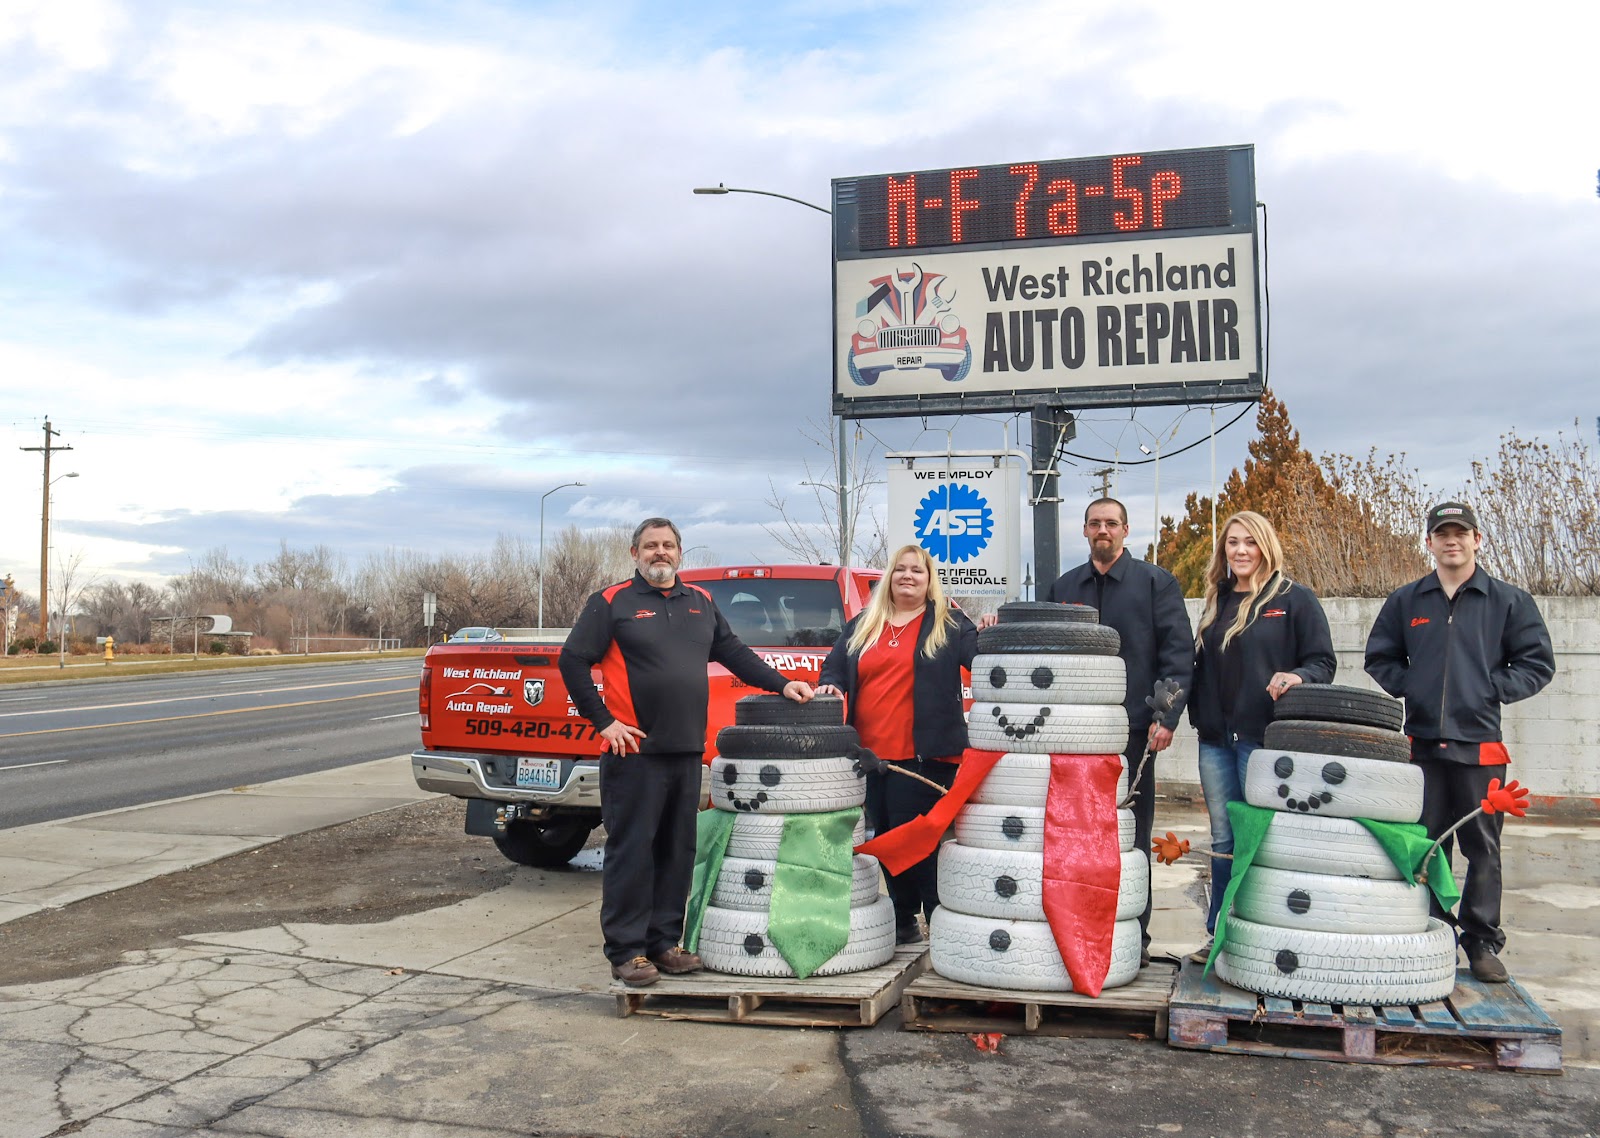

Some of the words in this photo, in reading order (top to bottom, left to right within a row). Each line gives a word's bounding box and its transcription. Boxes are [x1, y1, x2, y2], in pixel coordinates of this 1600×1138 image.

[888, 169, 980, 247] M-F
[1009, 156, 1182, 238] 7a-5p
[981, 265, 1069, 302] West
[1082, 247, 1236, 297] Richland
[982, 306, 1086, 373] AUTO
[1098, 298, 1240, 367] REPAIR
[896, 355, 923, 366] REPAIR
[914, 471, 936, 480] WE
[938, 470, 994, 480] EMPLOY
[922, 508, 982, 536] ASE
[937, 568, 987, 577] RTIFIED
[938, 576, 1007, 585] SSIONALS
[443, 667, 470, 679] West
[472, 668, 522, 681] Richland
[445, 700, 474, 712] Auto
[475, 701, 514, 716] Repair
[465, 719, 598, 742] 509-420-477
[518, 767, 558, 784] B84416T
